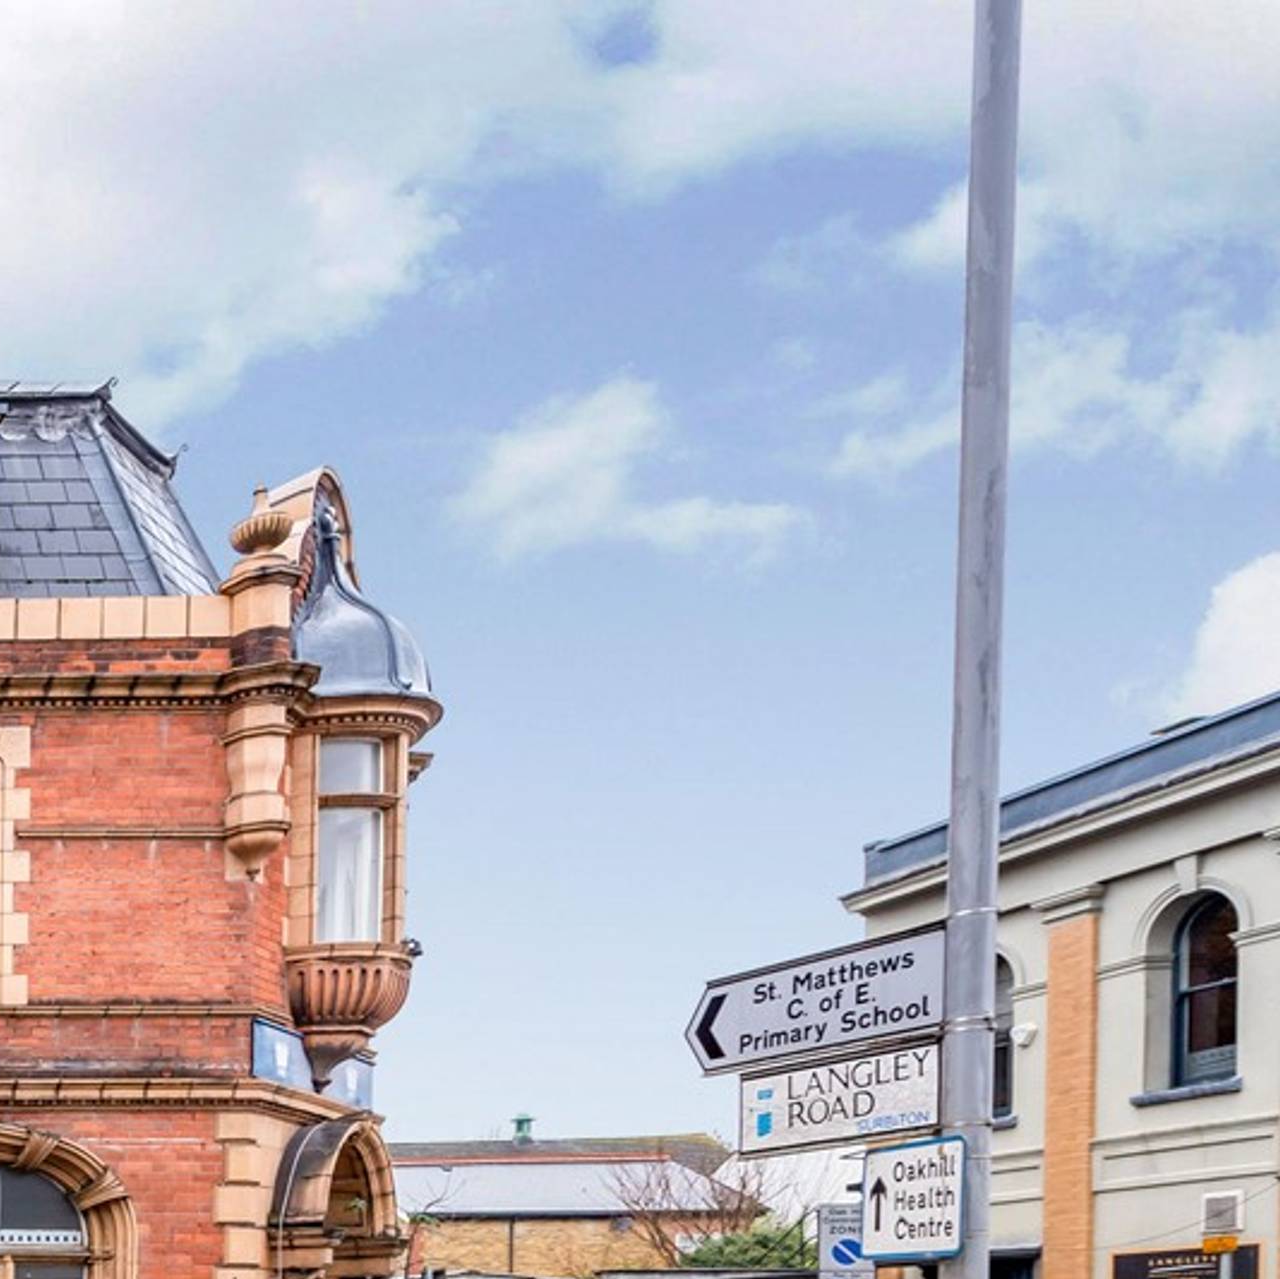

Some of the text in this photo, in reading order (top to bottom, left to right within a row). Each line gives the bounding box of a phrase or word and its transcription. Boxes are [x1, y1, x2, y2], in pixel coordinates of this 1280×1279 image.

[753, 952, 915, 1004] St. Matthews
[787, 983, 876, 1020] C. of E.
[739, 995, 930, 1053] Primary School
[788, 1050, 931, 1100] LANGLEY
[788, 1090, 876, 1129] ROAD
[893, 1155, 955, 1182] Oakhill
[894, 1186, 955, 1211] Health
[894, 1217, 953, 1240] Centre
